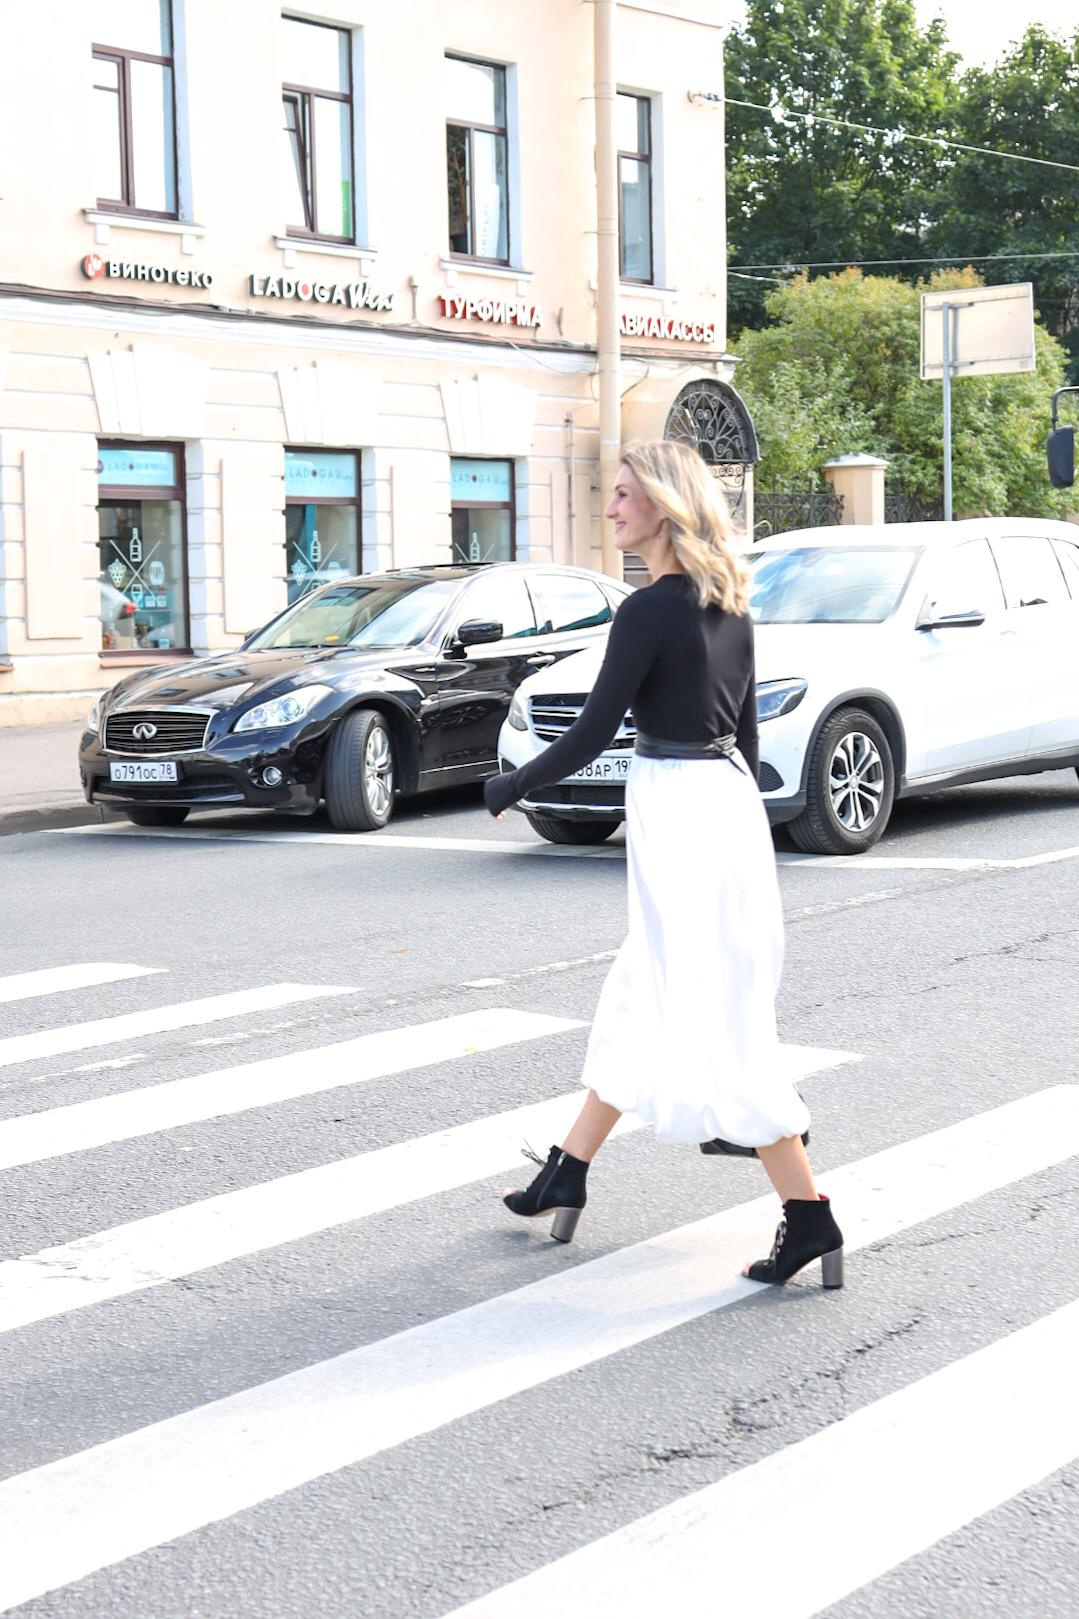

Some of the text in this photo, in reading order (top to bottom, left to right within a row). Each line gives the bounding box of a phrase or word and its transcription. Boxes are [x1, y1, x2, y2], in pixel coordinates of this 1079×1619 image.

[250, 274, 345, 304] LADOGA
[438, 294, 544, 328] ТУРФИРМА
[614, 760, 632, 773] 19
